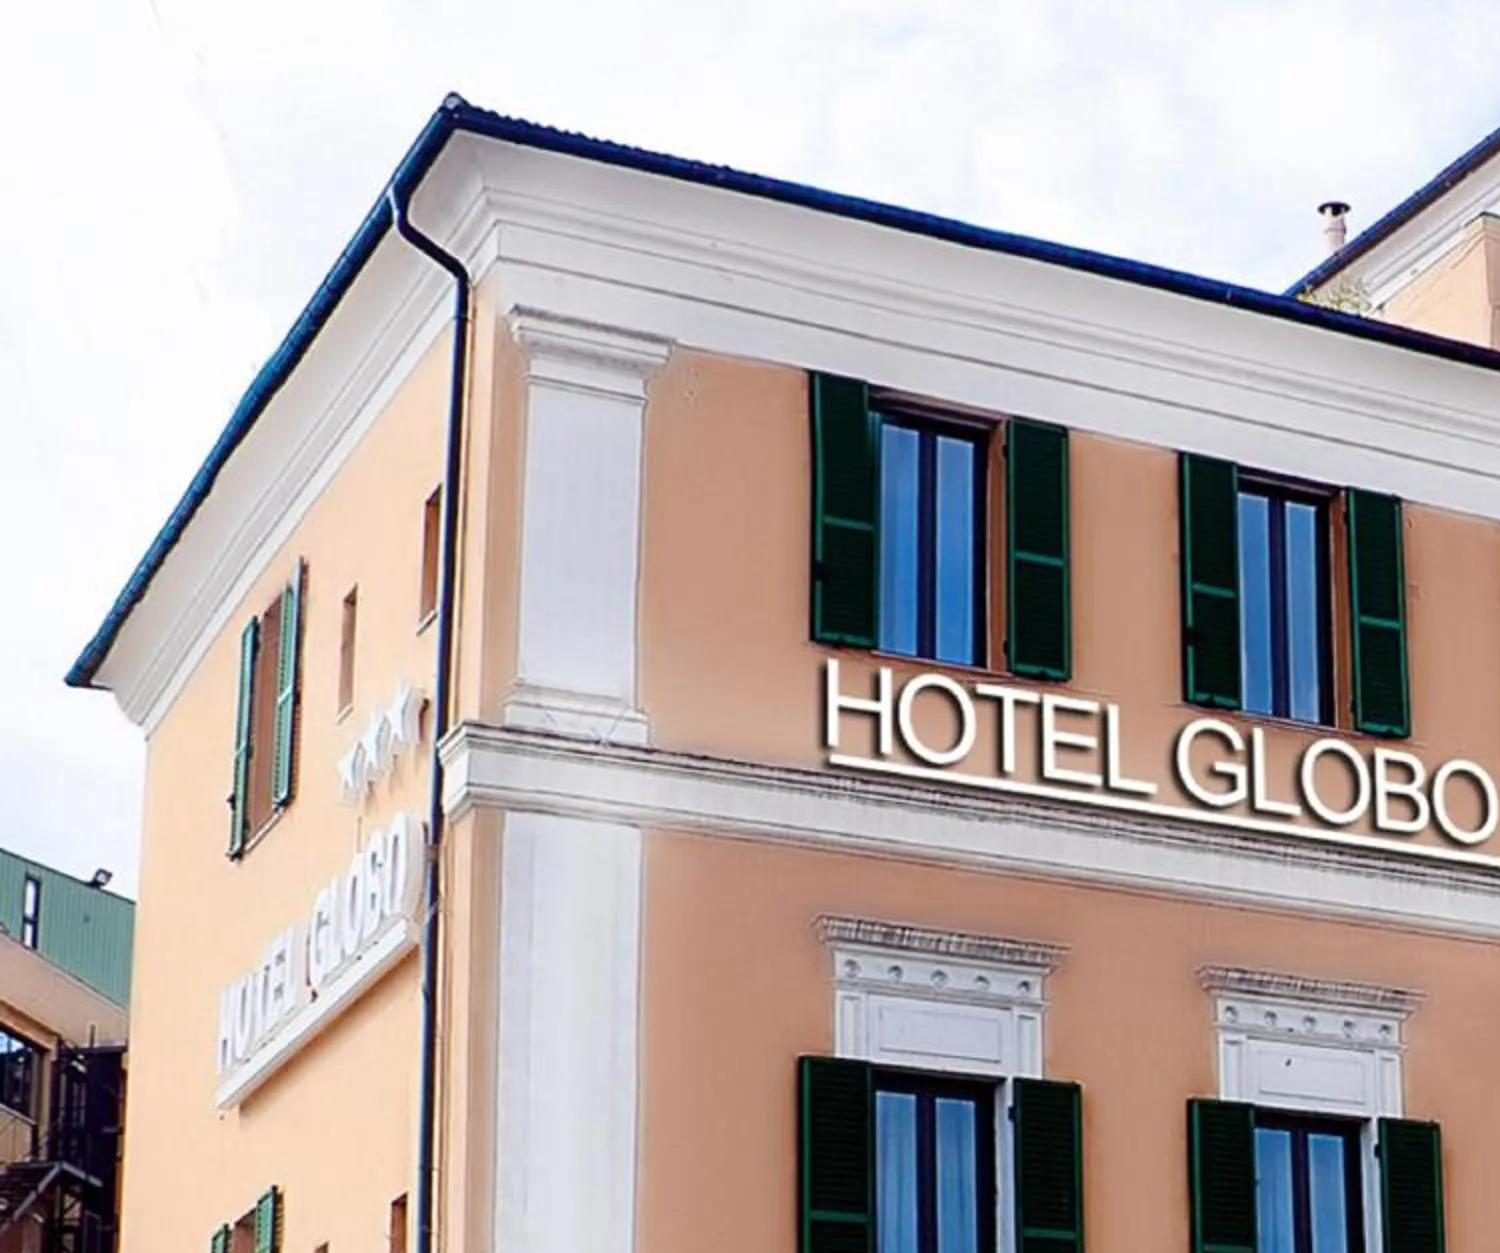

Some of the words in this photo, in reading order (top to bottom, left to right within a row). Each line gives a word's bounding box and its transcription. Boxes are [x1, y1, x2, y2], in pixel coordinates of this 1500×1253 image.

[825, 657, 1157, 797] HOTEL
[1175, 717, 1500, 845] GLOBO
[217, 920, 302, 1074] HOTEL
[307, 810, 420, 989] GLOBO
